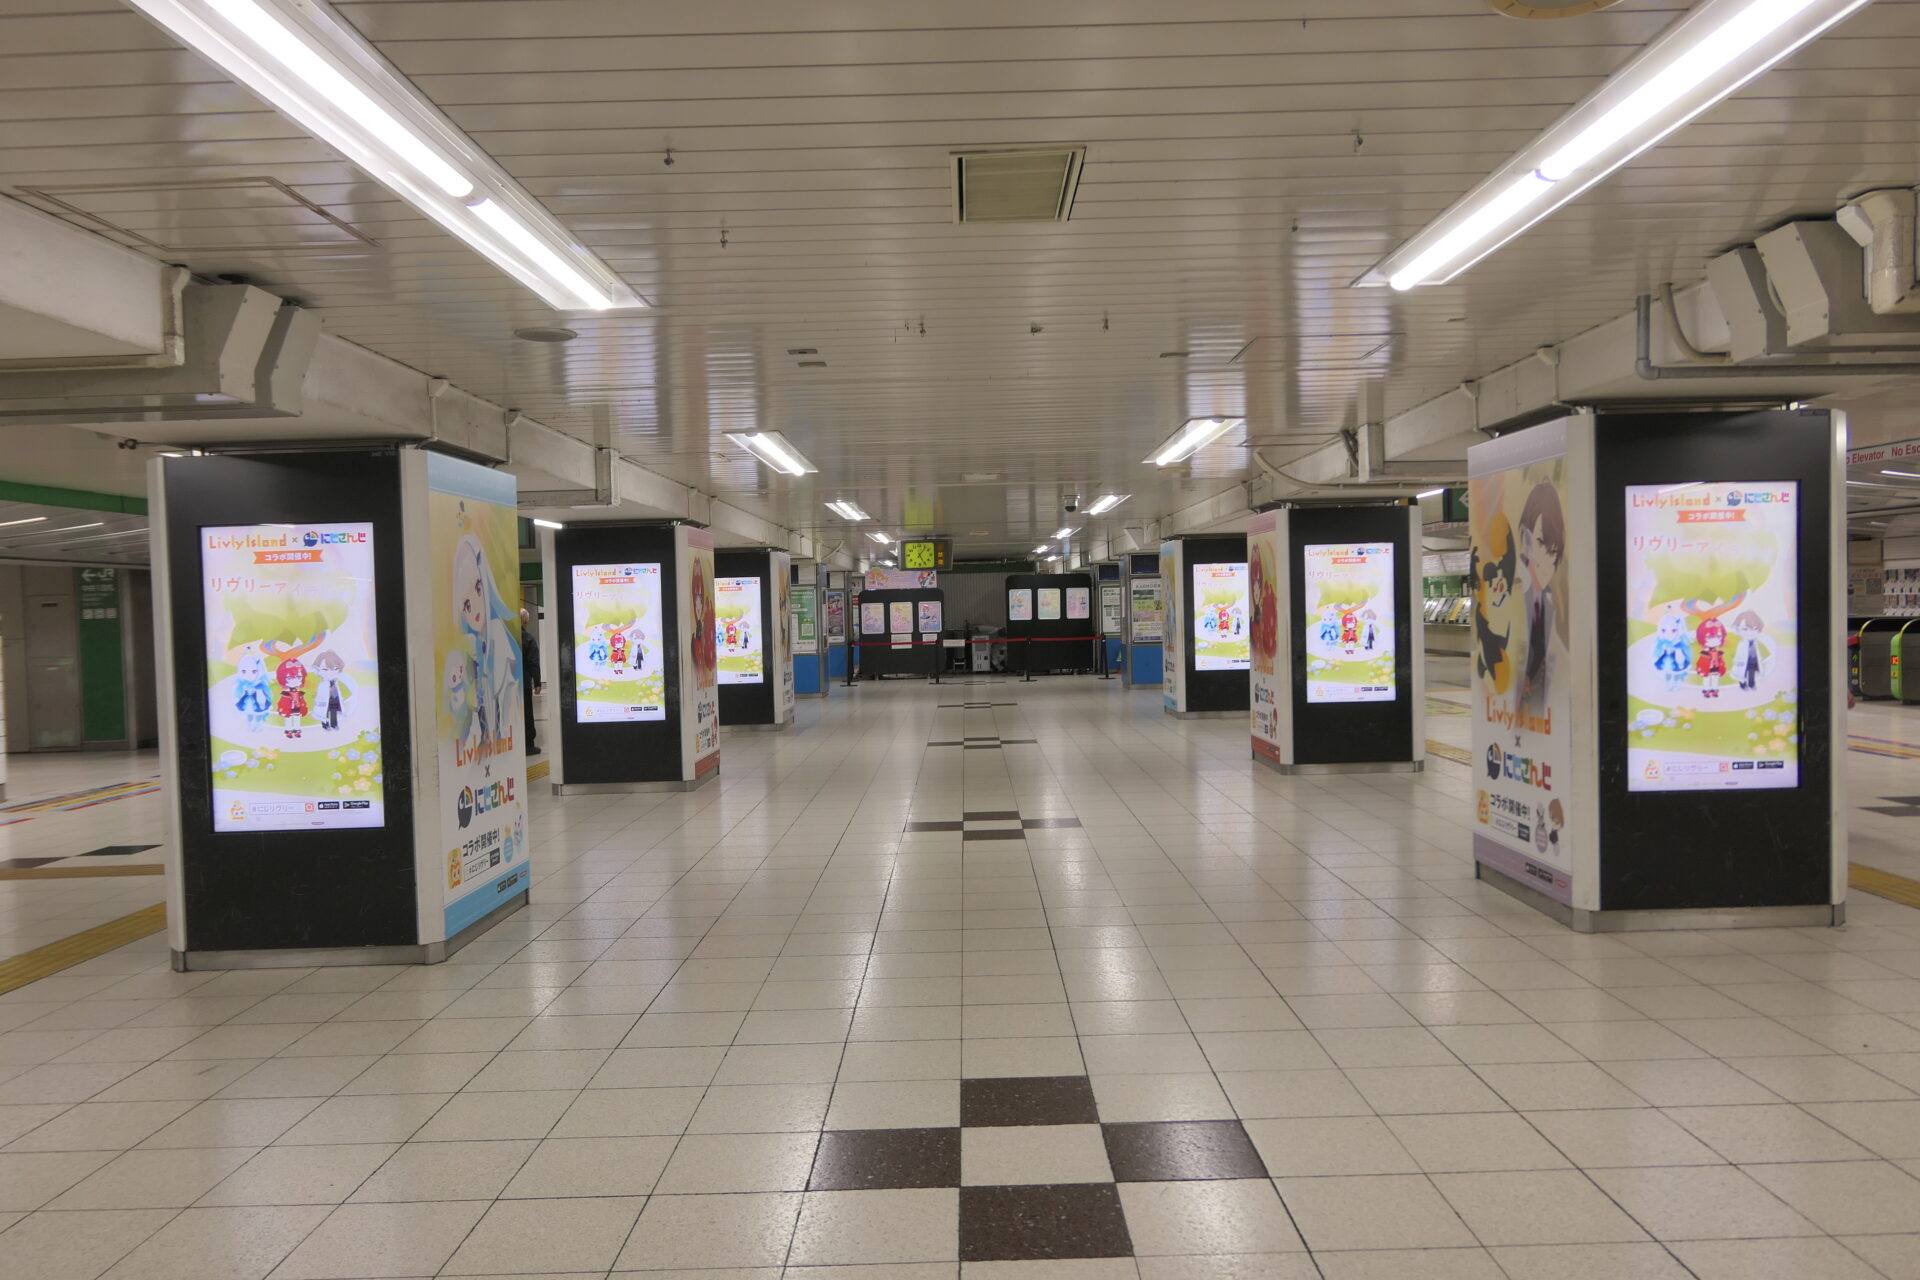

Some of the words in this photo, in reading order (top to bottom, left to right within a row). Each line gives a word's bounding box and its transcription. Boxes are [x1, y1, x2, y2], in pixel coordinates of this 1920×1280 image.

[1852, 451, 1884, 464] Elevator
[1891, 447, 1903, 456] No
[1633, 494, 1667, 508] Livly
[1670, 493, 1710, 506] Island
[1744, 492, 1789, 503] にじさんじ
[209, 535, 244, 550] Livly
[246, 533, 286, 548] Island
[320, 532, 366, 544] にじさんじ
[1486, 695, 1514, 730] Livly
[1515, 702, 1552, 735] Island
[455, 734, 482, 767] Livly
[484, 725, 513, 758] Island
[1503, 751, 1552, 791] にじさんじ
[475, 777, 515, 816] にじさんじ
[1490, 793, 1531, 821] コラボ開催中!
[462, 827, 500, 857] コラボ開催中!
